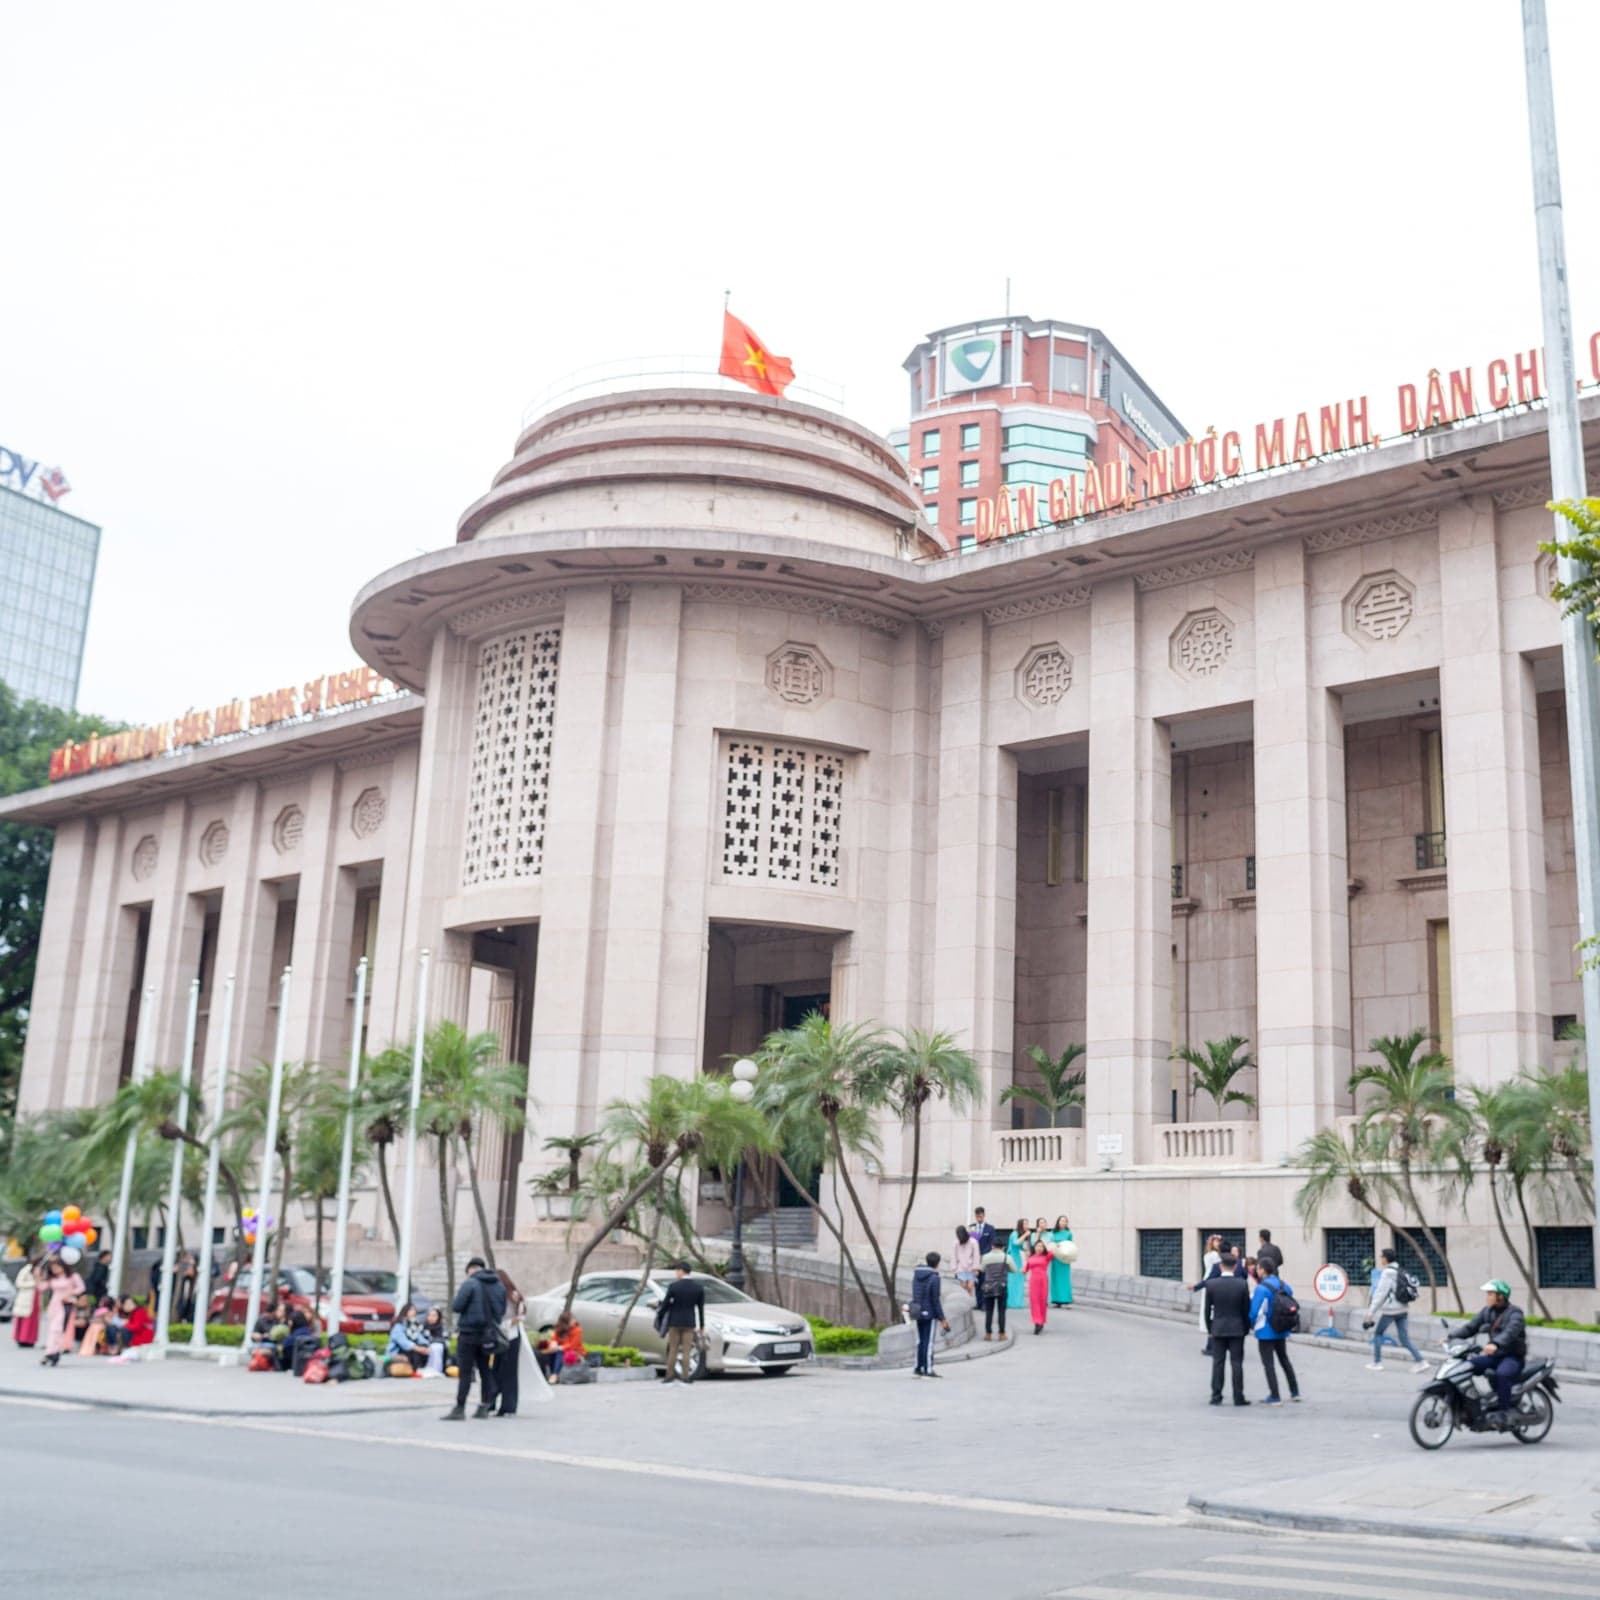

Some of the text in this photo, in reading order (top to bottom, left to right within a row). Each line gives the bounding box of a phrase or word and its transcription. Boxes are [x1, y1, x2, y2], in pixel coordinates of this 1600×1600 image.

[974, 485, 1039, 543] DÂN
[1050, 460, 1135, 522] GIÀU,
[1148, 425, 1240, 497] NƯỚC
[1255, 396, 1381, 471] MẠNH,
[1398, 368, 1474, 432] DÂN
